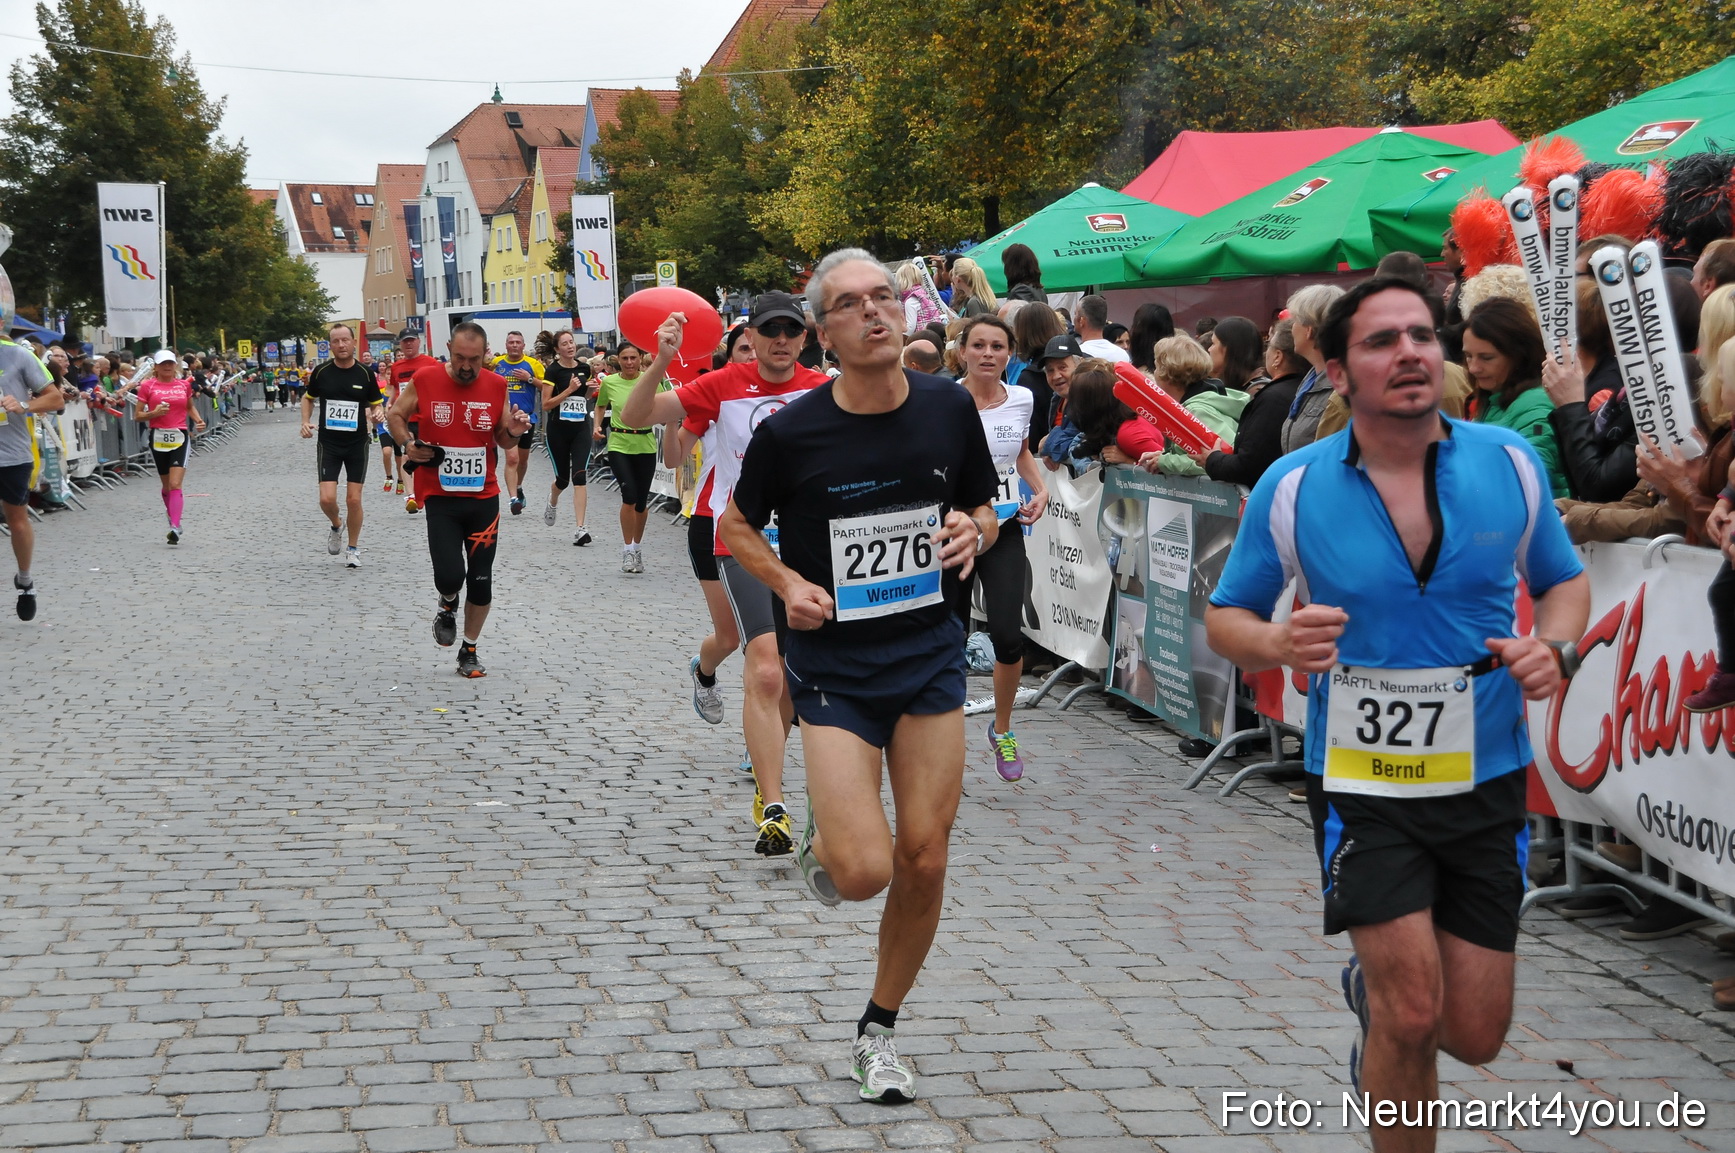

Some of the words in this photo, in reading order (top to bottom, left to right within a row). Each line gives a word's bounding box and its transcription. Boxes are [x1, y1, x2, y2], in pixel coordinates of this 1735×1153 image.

[1068, 234, 1156, 248] Neumarkte
[1638, 288, 1664, 343] BMW
[1608, 298, 1642, 355] BMW
[241, 345, 249, 355] D
[329, 407, 356, 420] 2447
[563, 402, 584, 412] 2448
[1171, 401, 1189, 417] BKK
[1624, 361, 1665, 448] Laufspo
[163, 433, 176, 443] 85
[1163, 427, 1182, 445] BKK
[1183, 443, 1198, 456] udi
[443, 457, 483, 475] 3315
[445, 477, 477, 486] JOSEF
[833, 527, 870, 539] PARTL
[873, 519, 922, 535] Neumarkt
[844, 532, 932, 580] 2276
[1167, 544, 1189, 560] HOFFER
[866, 583, 916, 603] Werner
[1333, 673, 1376, 691] PARTL
[1380, 680, 1447, 694] Neumarkt
[1356, 697, 1445, 747] 327
[1372, 758, 1425, 779] Bernd
